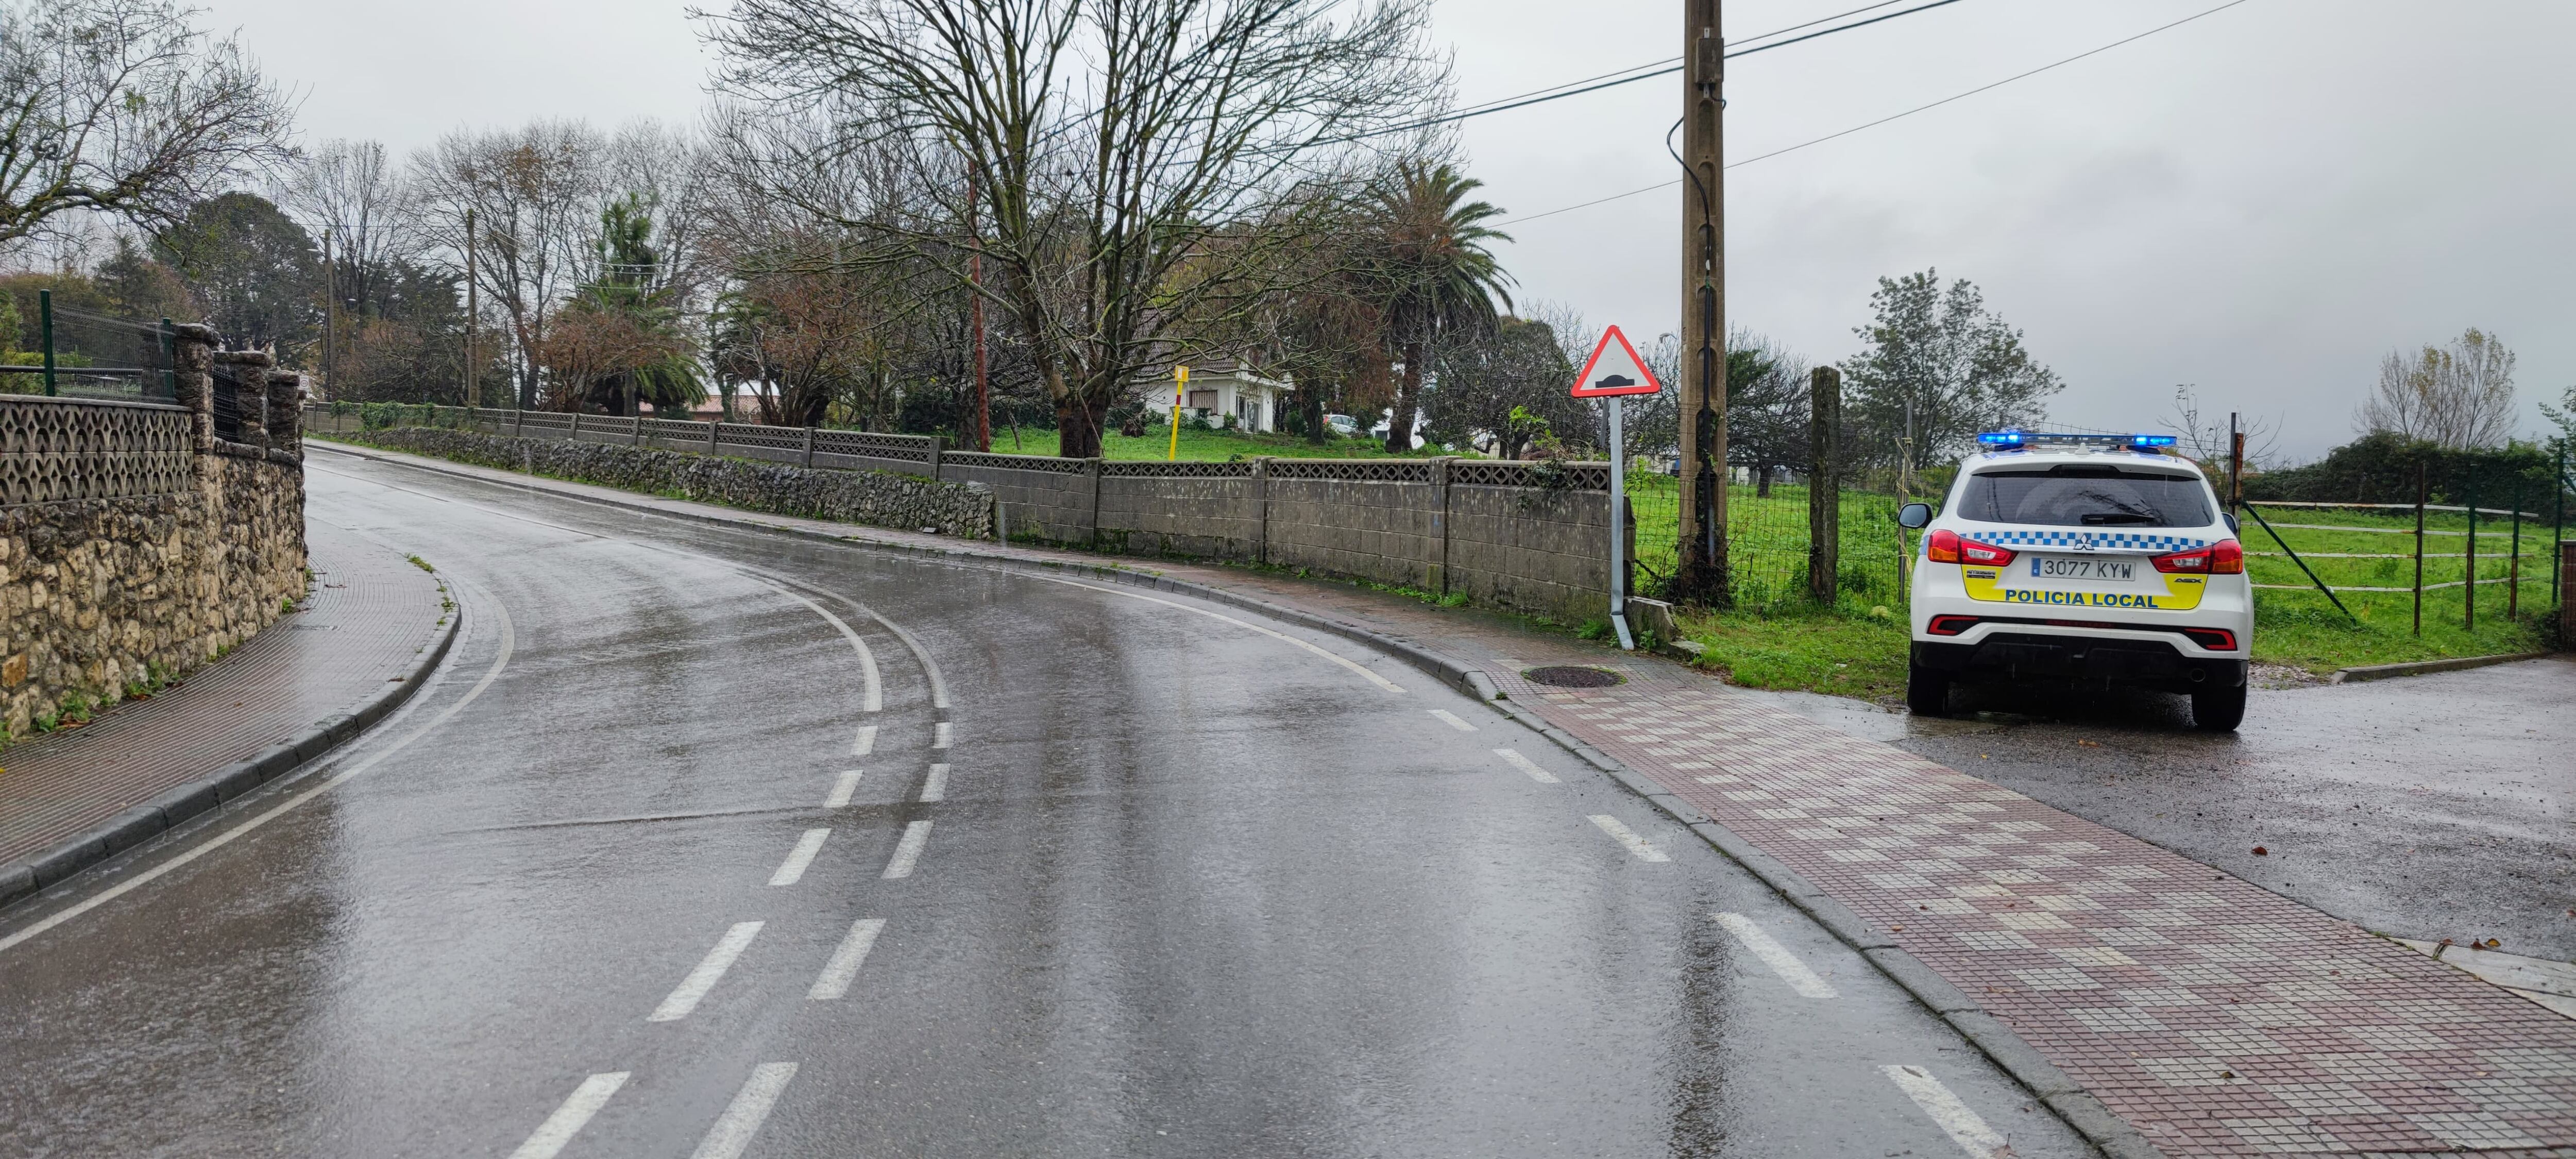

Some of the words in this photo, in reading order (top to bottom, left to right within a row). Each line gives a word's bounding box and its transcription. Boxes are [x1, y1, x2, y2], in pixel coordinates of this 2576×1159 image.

[2045, 560, 2090, 576] 3077
[2097, 563, 2131, 578] KYW
[2005, 589, 2085, 605] POLICIA
[2092, 593, 2159, 608] LOCAL
